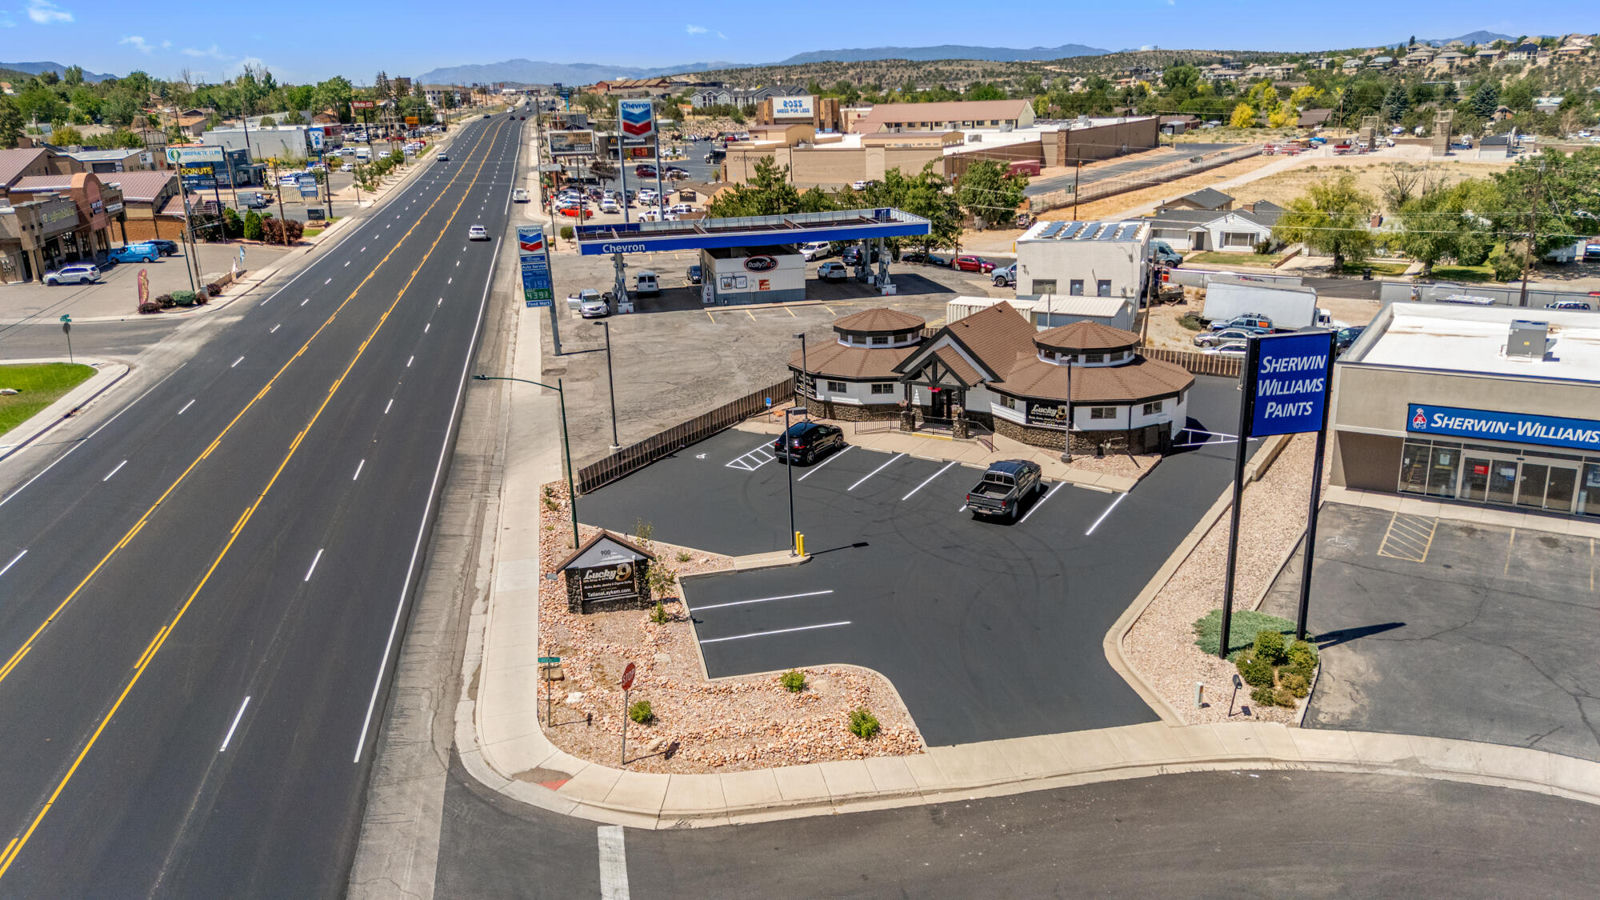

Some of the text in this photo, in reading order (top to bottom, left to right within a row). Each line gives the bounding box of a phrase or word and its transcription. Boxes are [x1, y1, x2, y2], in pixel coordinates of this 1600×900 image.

[621, 102, 651, 110] Chevron
[180, 167, 213, 175] DONUTS
[602, 243, 646, 253] Chevron
[1261, 355, 1326, 373] SHERWIN
[1258, 378, 1324, 397] WILLIAMS
[1031, 404, 1057, 417] Lucky
[1264, 402, 1313, 419] PAINTS
[584, 569, 617, 580] Lucky
